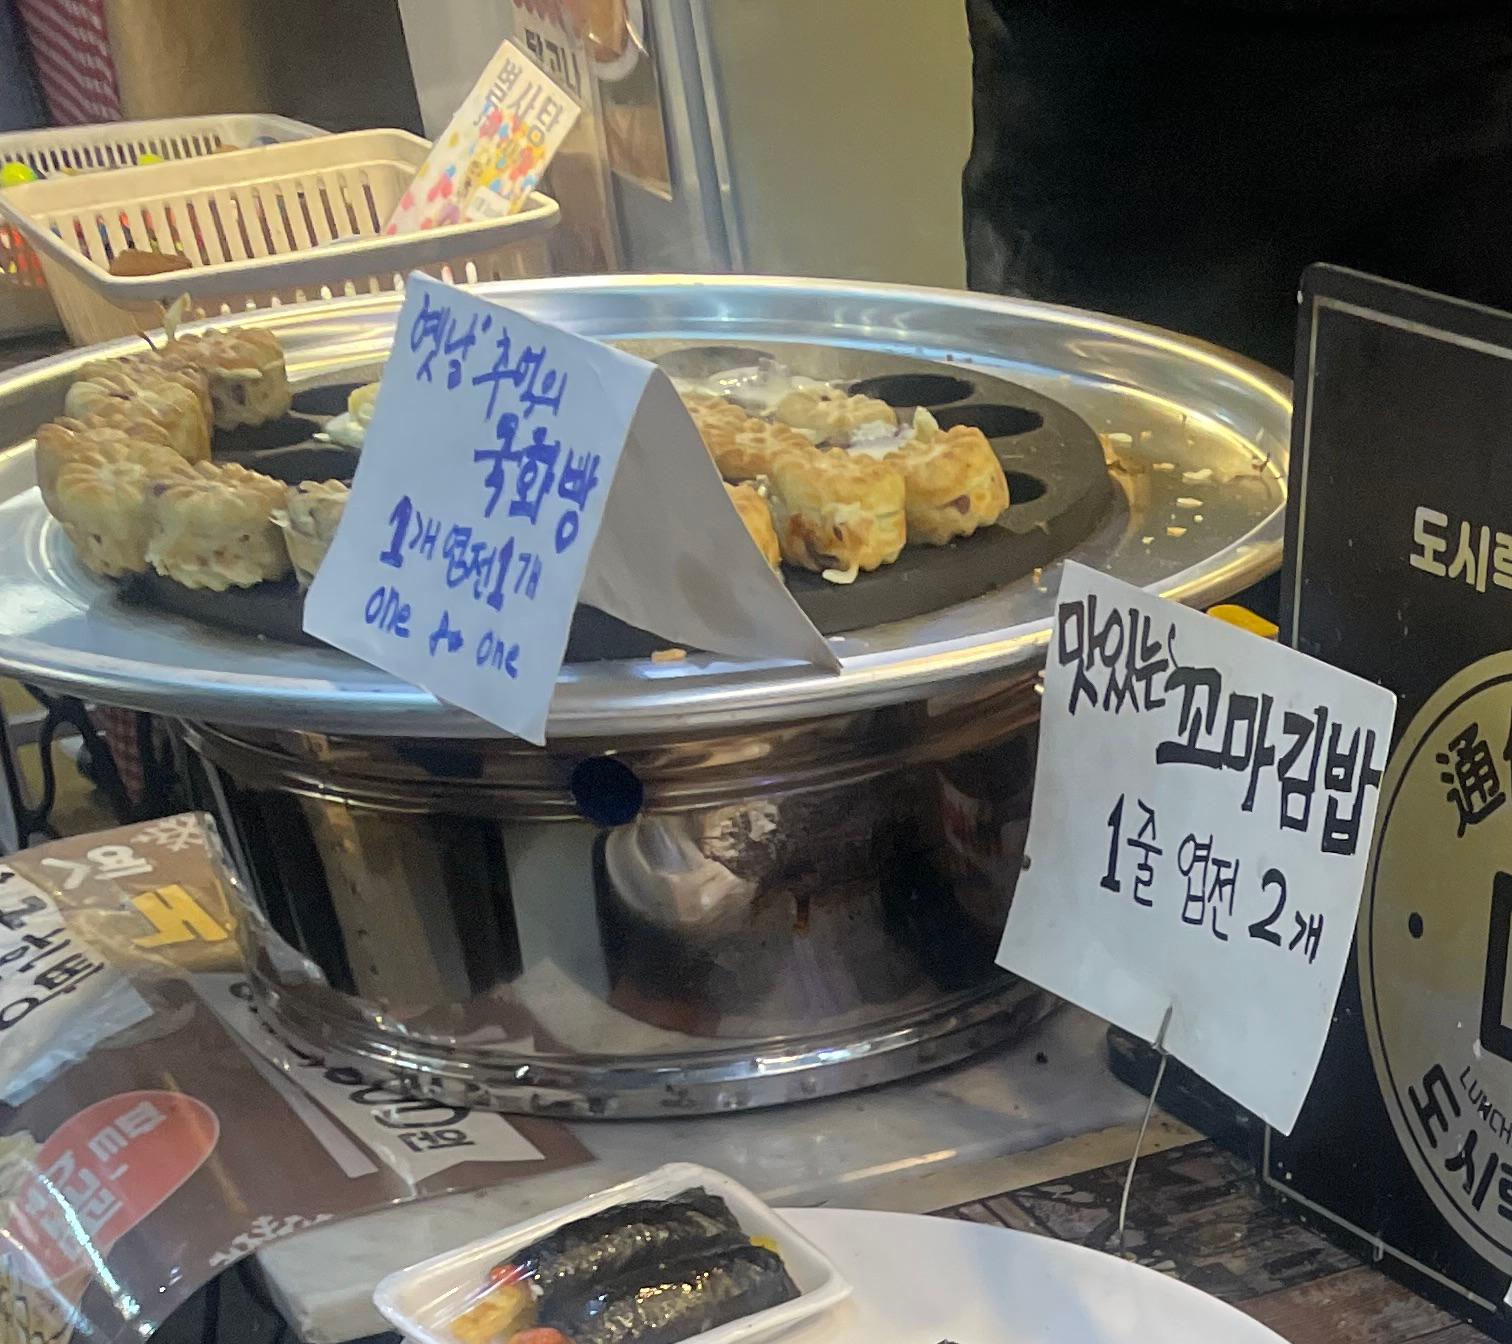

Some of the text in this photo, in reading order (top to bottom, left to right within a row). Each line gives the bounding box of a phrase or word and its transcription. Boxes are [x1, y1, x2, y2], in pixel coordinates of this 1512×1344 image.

[473, 412, 601, 553] 국화빵
[364, 585, 412, 639] one
[475, 629, 521, 679] one
[1155, 666, 1384, 856] 꼬마김밥
[1099, 793, 1163, 908] 1줄
[1247, 868, 1325, 964] 2개
